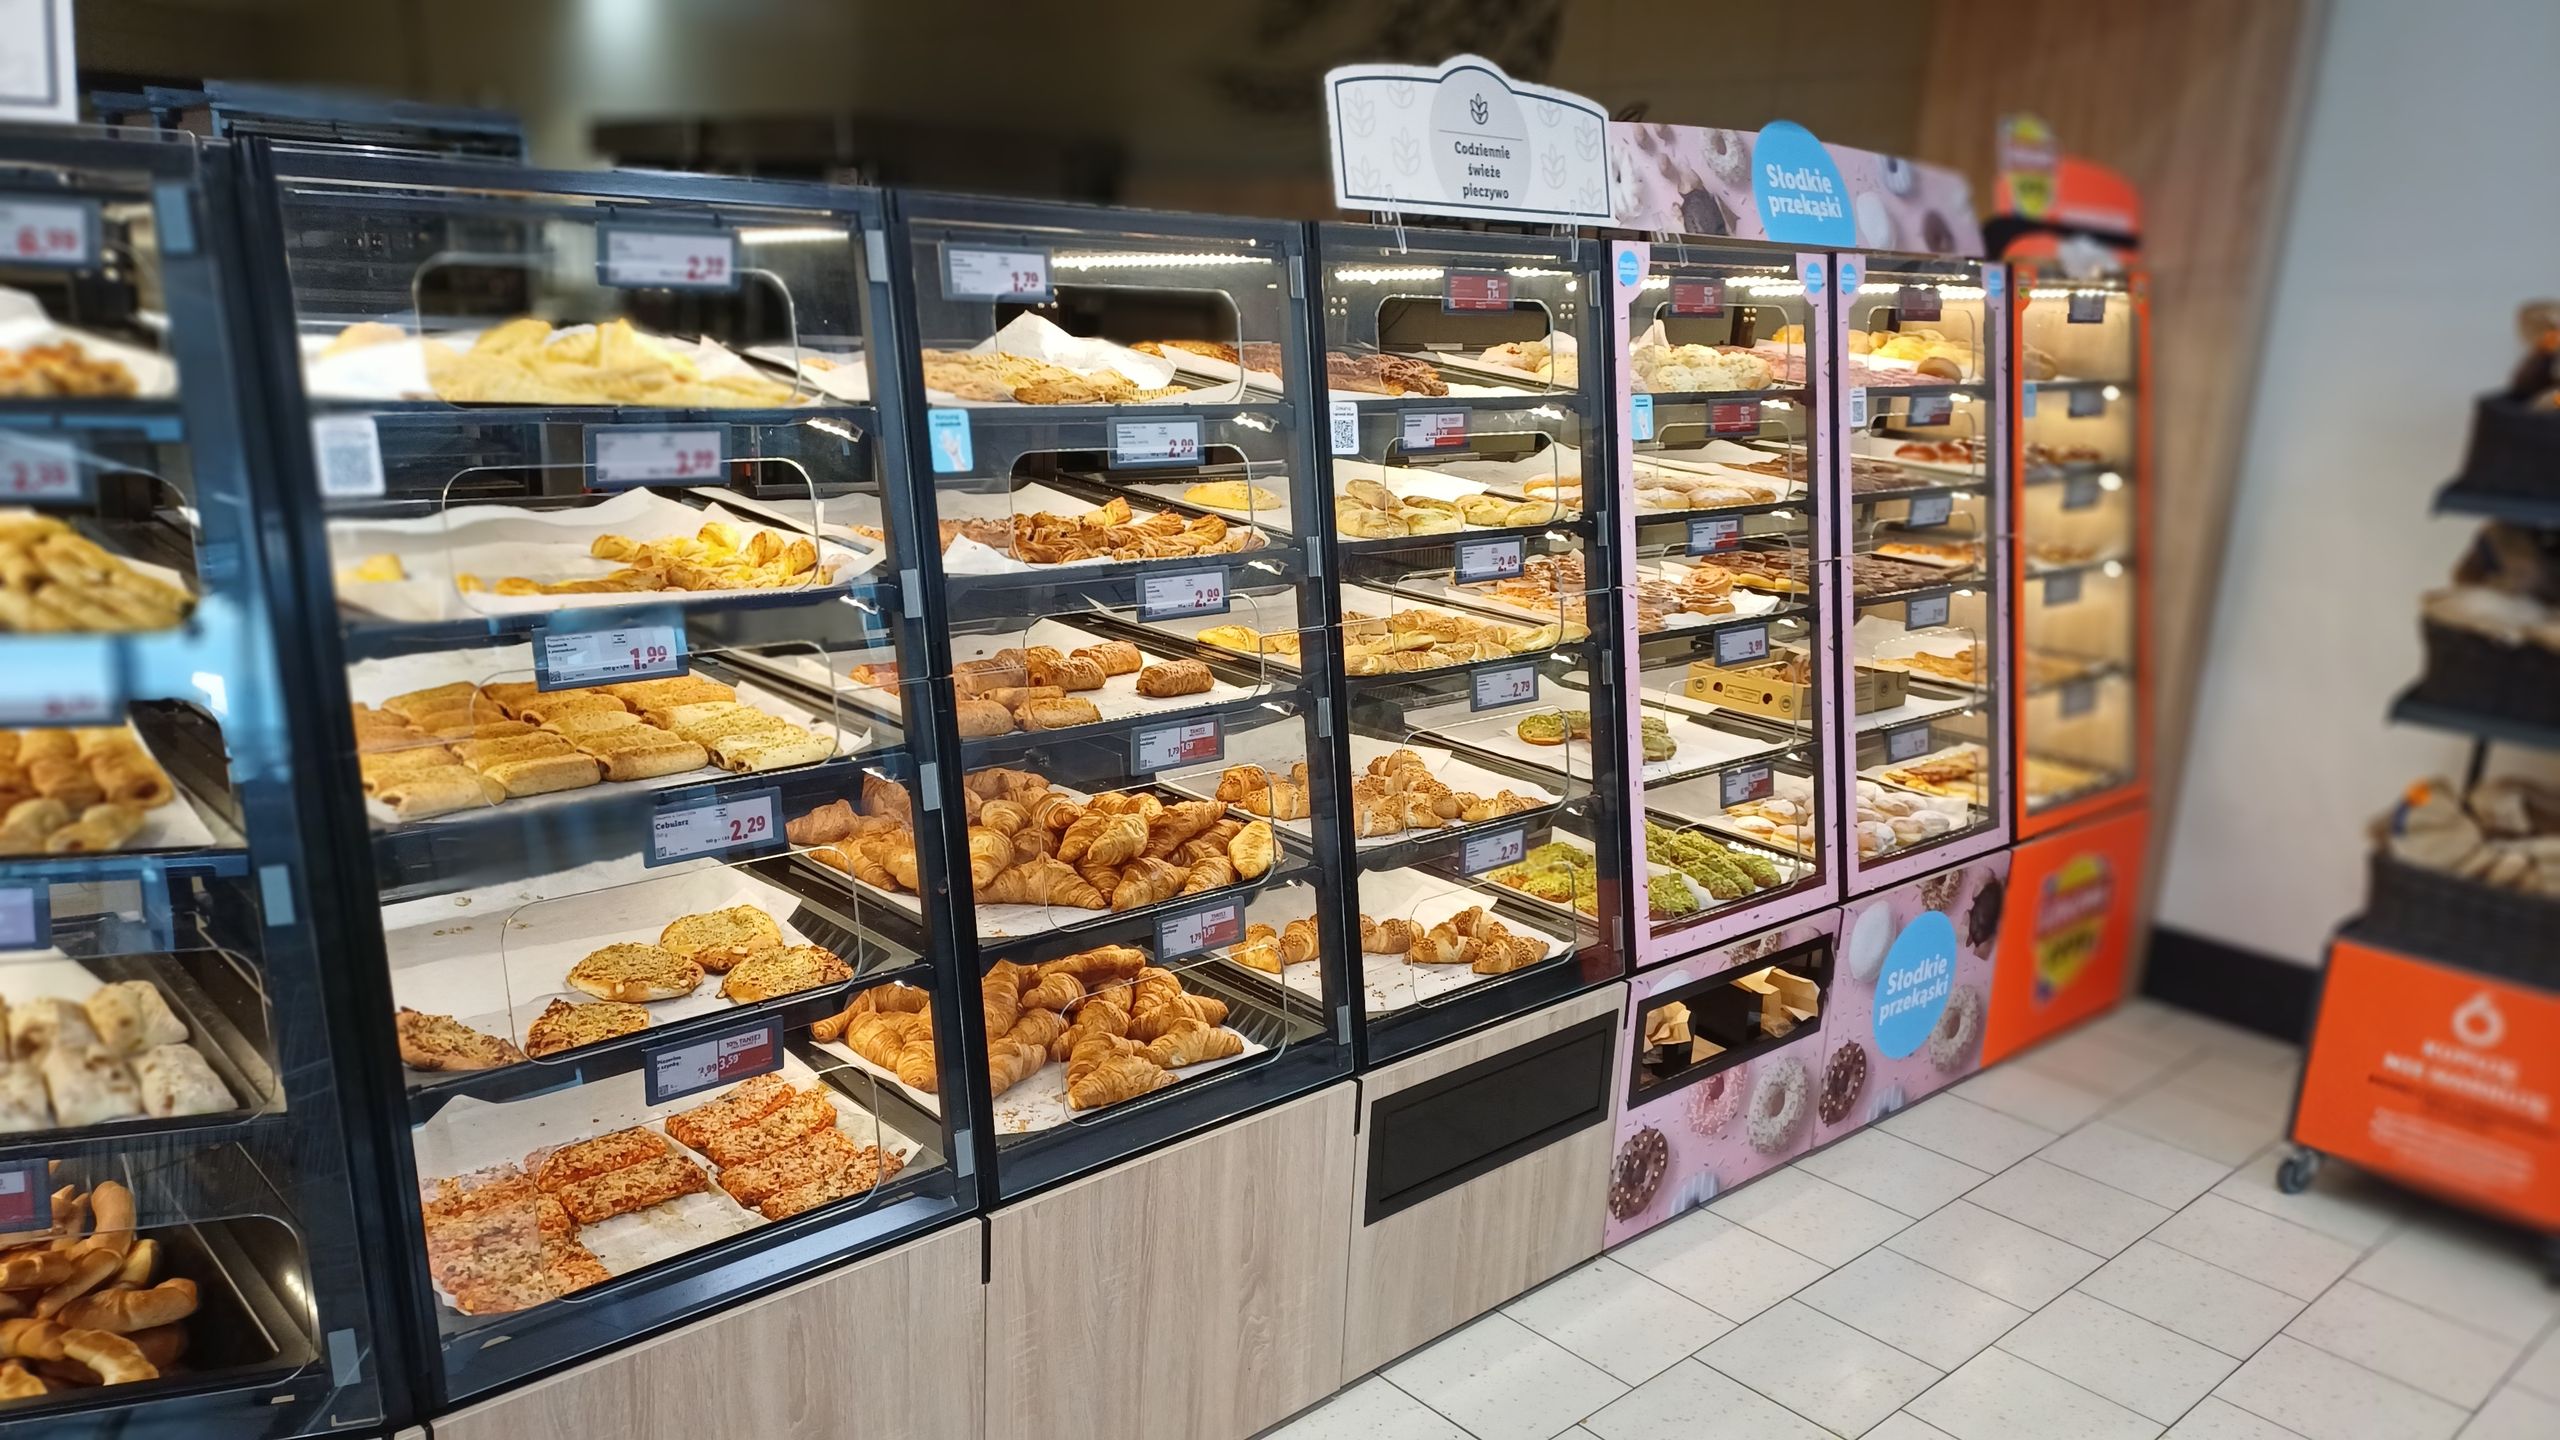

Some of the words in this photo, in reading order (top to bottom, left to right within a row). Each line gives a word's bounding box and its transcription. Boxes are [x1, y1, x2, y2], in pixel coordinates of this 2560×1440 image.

[1454, 141, 1511, 159] Codziennie
[1468, 163, 1501, 178] świeże
[1765, 163, 1833, 194] Słodkie
[1462, 183, 1509, 200] pieczywo
[1767, 193, 1843, 221] przekąski
[1168, 439, 1194, 458] 2.99
[1194, 588, 1220, 608] 2.99
[629, 645, 667, 670] 1.99
[1512, 680, 1530, 697] 2.79
[655, 819, 689, 830] Cebularz
[729, 815, 766, 841] 2.29
[1501, 842, 1519, 860] 2.79
[1886, 953, 1947, 995] Słodkie
[1878, 973, 1949, 1026] przekąski
